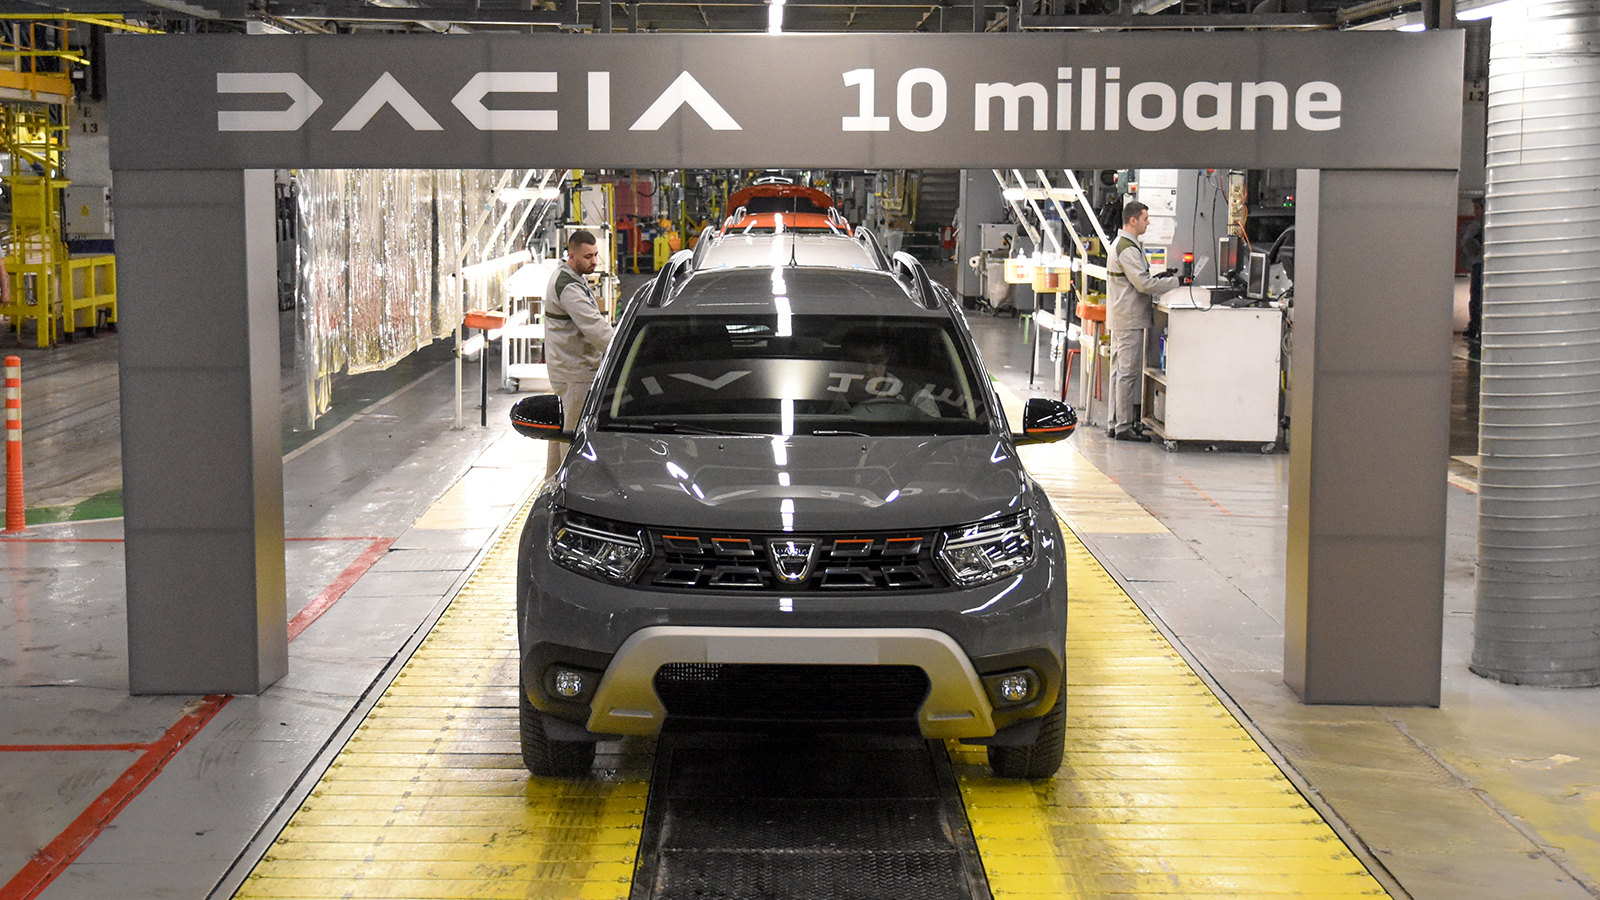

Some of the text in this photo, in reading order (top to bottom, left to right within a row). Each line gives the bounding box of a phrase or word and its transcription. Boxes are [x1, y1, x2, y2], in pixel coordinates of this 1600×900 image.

[216, 66, 1342, 133] DACIA 10 milioane
[1469, 91, 1484, 102] 12
[82, 122, 98, 133] 13
